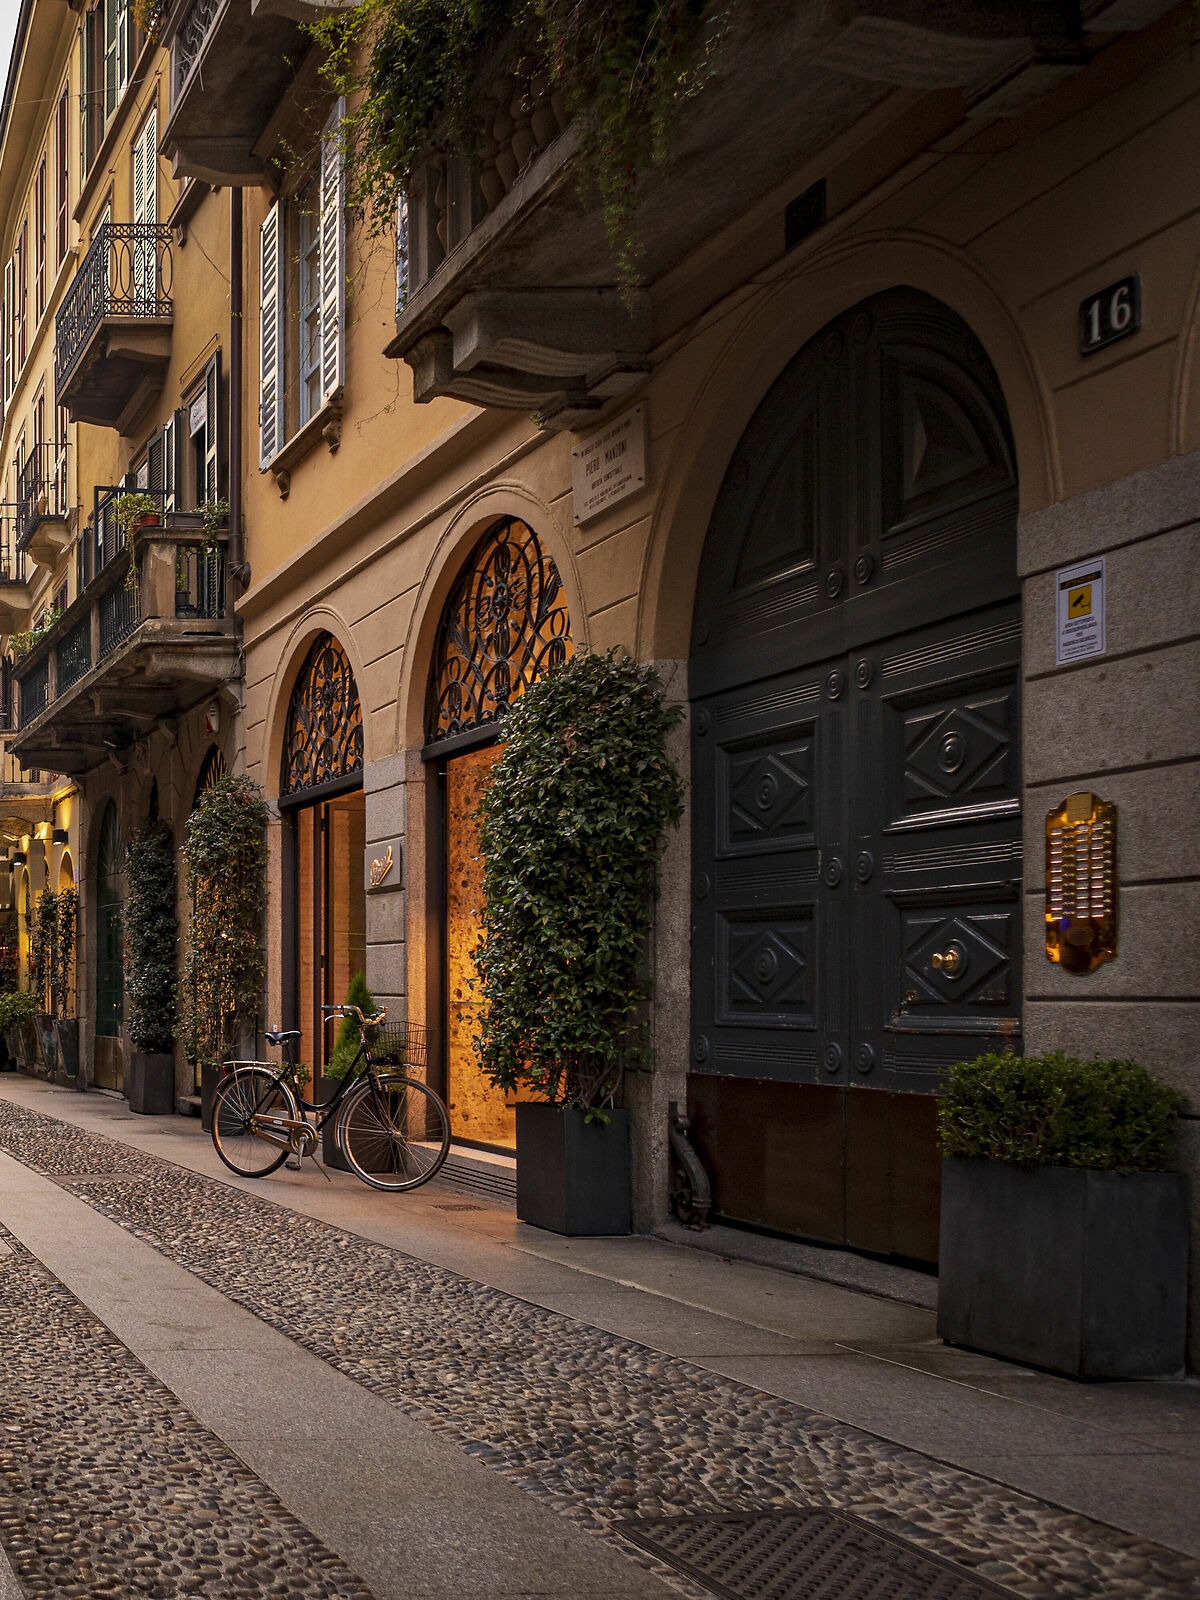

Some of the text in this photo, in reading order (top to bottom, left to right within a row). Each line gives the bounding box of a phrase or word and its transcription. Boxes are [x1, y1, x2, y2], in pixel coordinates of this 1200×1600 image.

[1088, 286, 1131, 344] 16
[586, 439, 627, 477] PIERO MANZONI
